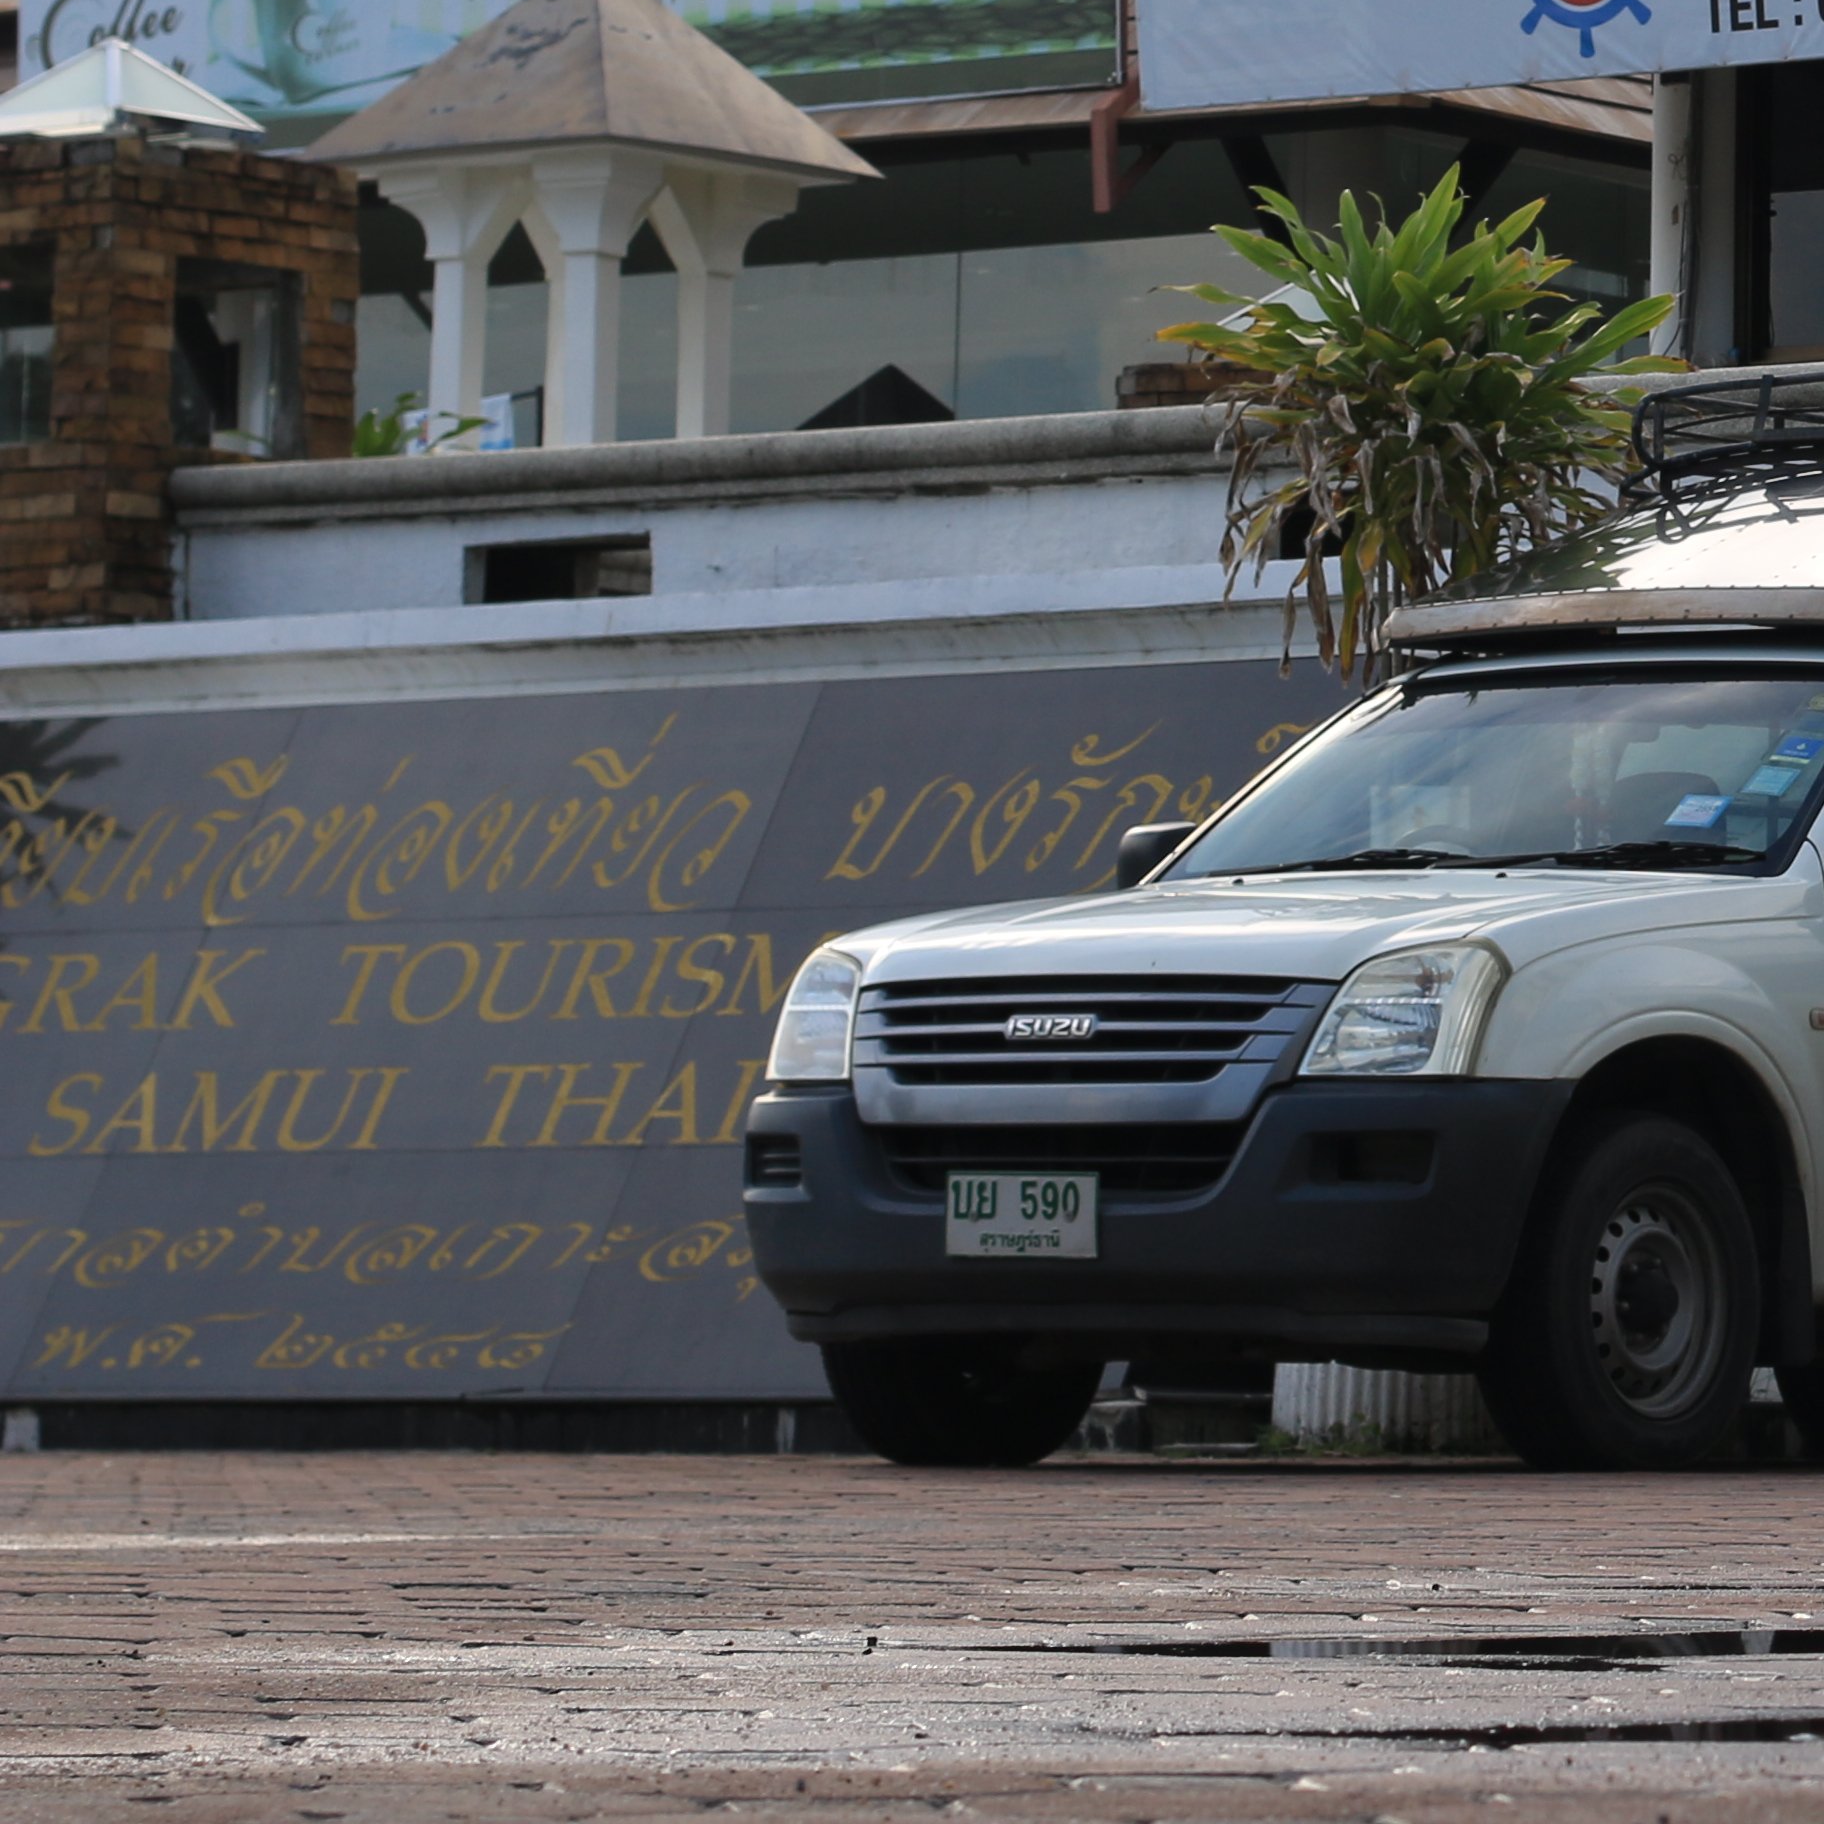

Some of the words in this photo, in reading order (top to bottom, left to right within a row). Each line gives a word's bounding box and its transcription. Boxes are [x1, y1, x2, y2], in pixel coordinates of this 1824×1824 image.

[1007, 1017, 1091, 1037] ISUZU
[28, 1066, 408, 1157] SAMUI
[474, 1060, 775, 1147] THAI
[952, 1179, 997, 1220] บย
[1020, 1180, 1080, 1222] 590
